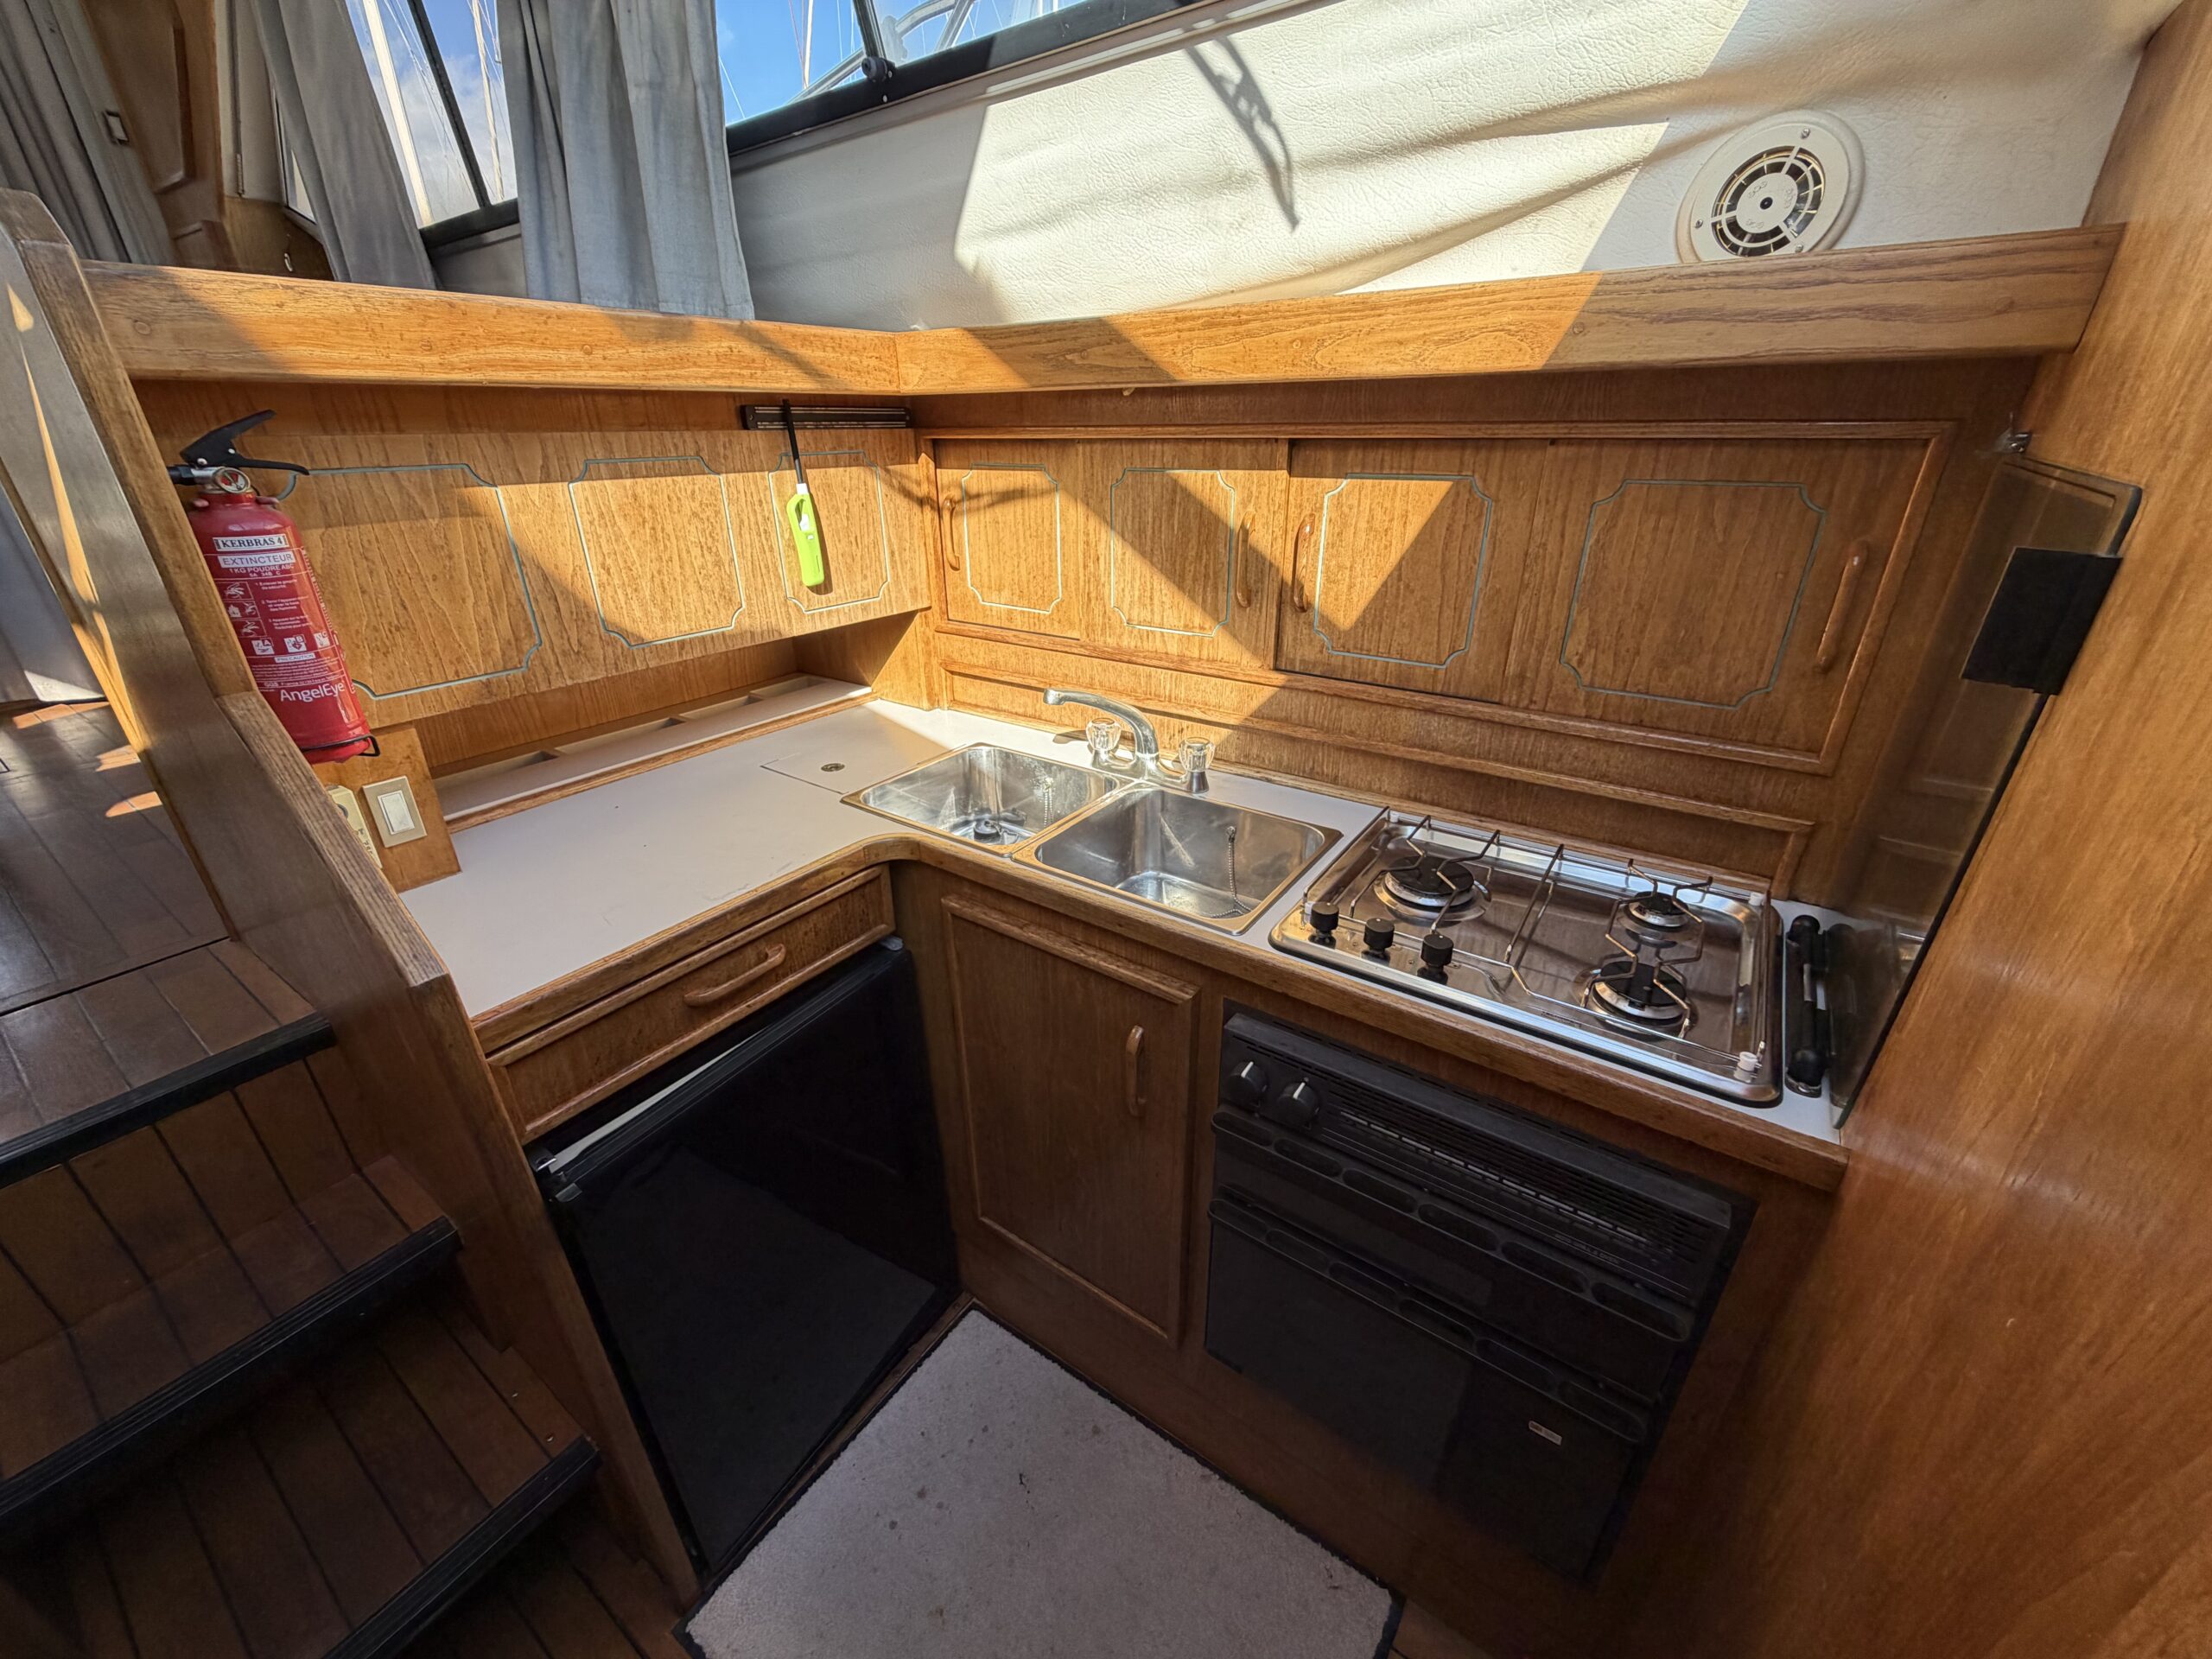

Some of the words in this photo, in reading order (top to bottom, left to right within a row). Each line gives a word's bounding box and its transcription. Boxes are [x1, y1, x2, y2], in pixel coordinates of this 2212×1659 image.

[221, 537, 275, 548] KERBRAS
[277, 536, 283, 544] 4
[223, 554, 293, 565] EXTINCTEUR
[280, 683, 345, 702] AngelEye
